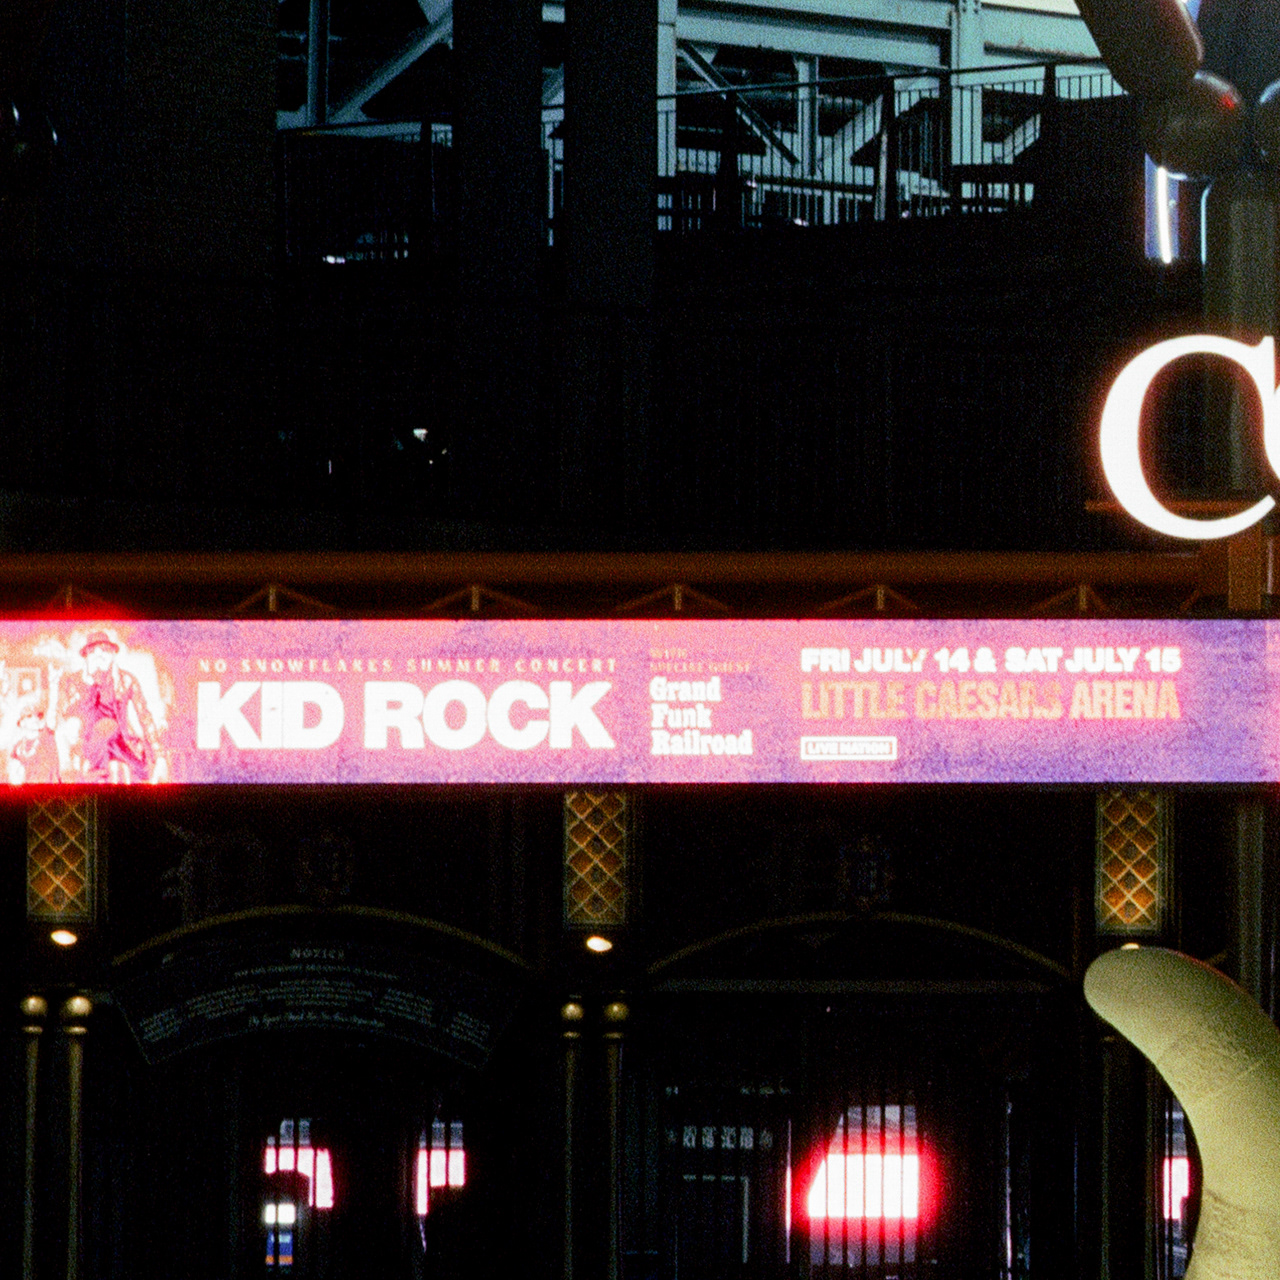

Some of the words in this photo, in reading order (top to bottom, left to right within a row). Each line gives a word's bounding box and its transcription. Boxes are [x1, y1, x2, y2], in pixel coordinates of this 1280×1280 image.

[199, 658, 227, 673] NO
[241, 658, 393, 673] SNOWFLAKES
[406, 657, 500, 673] SUMMER
[515, 657, 616, 673] CONCERT
[801, 647, 850, 673] FRI
[853, 647, 928, 673] JULY
[934, 647, 971, 673] 14
[974, 647, 997, 673] &
[1004, 647, 1063, 673] SAT
[1065, 647, 1140, 673] JULY
[1145, 647, 1182, 673] 15
[650, 676, 721, 702] Grand
[801, 681, 906, 720] LITTLE
[915, 681, 1063, 720] CAESARS
[1069, 681, 1182, 720] ARENA
[196, 681, 344, 749] KID
[364, 680, 615, 750] ROCK
[651, 703, 712, 728] Funk
[651, 729, 753, 755] Railroad
